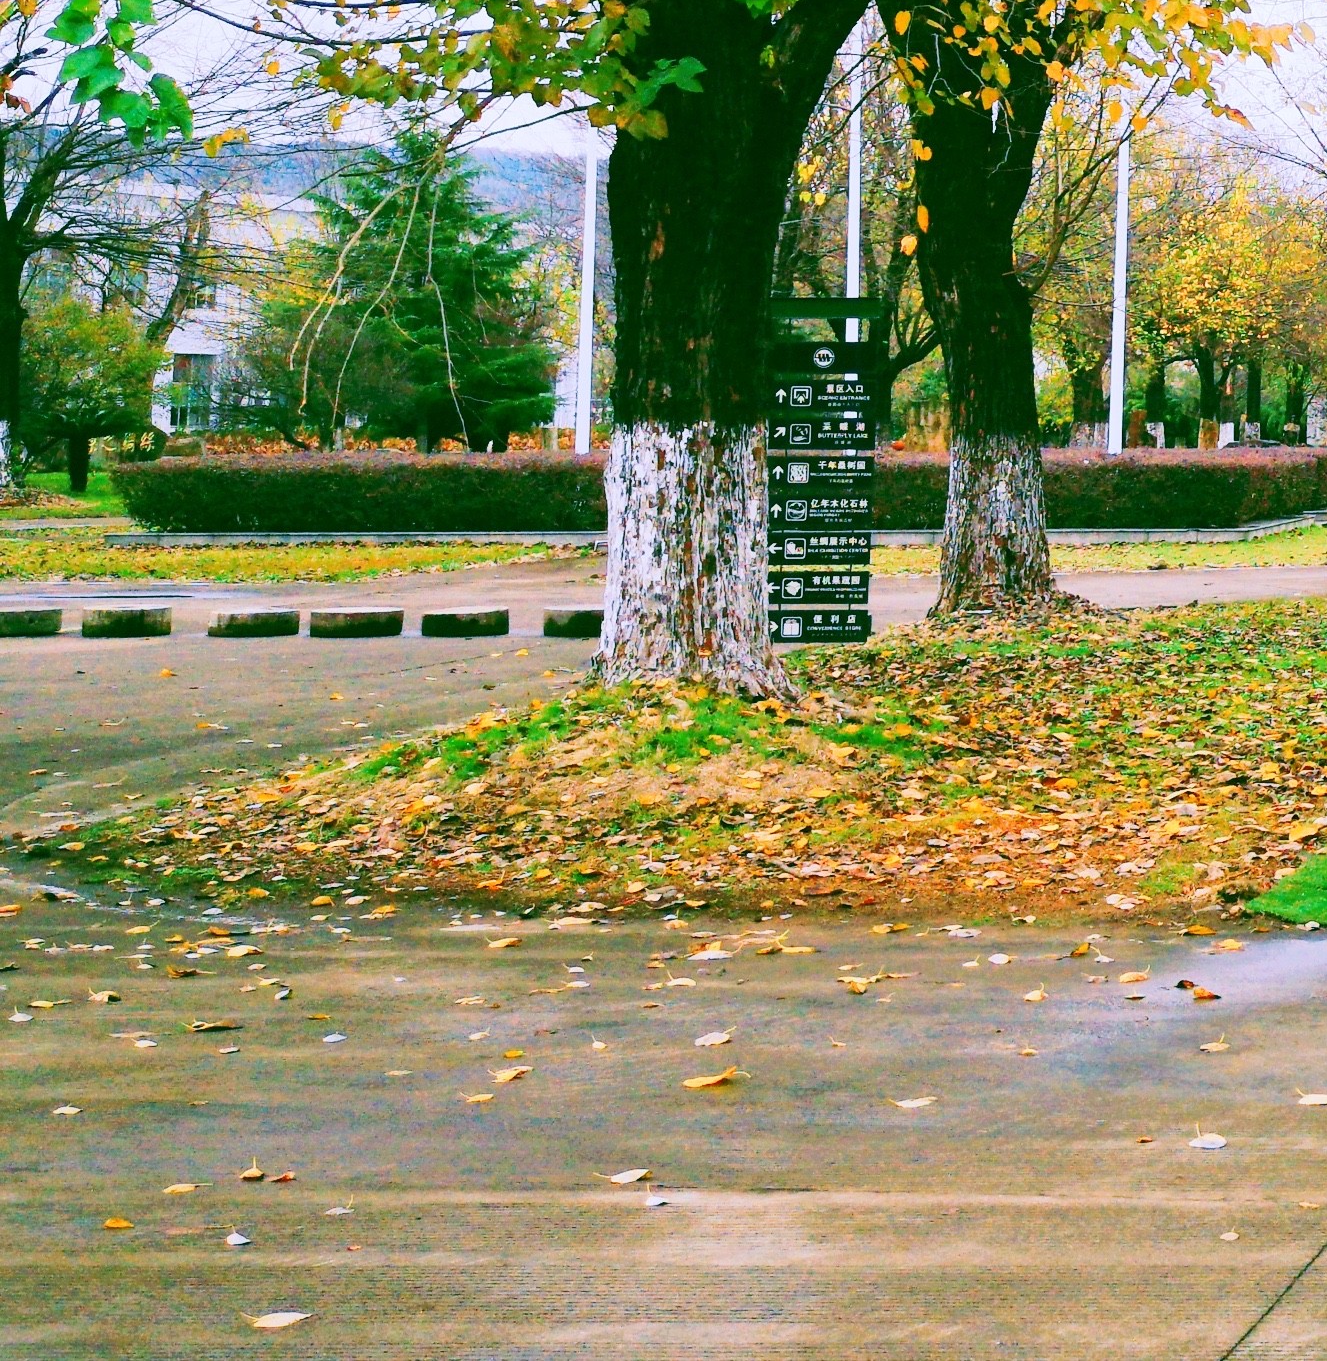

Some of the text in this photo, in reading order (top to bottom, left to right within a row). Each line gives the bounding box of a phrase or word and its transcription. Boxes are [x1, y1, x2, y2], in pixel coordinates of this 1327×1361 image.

[825, 383, 864, 394] 景区入口
[812, 614, 857, 624] 便利店
